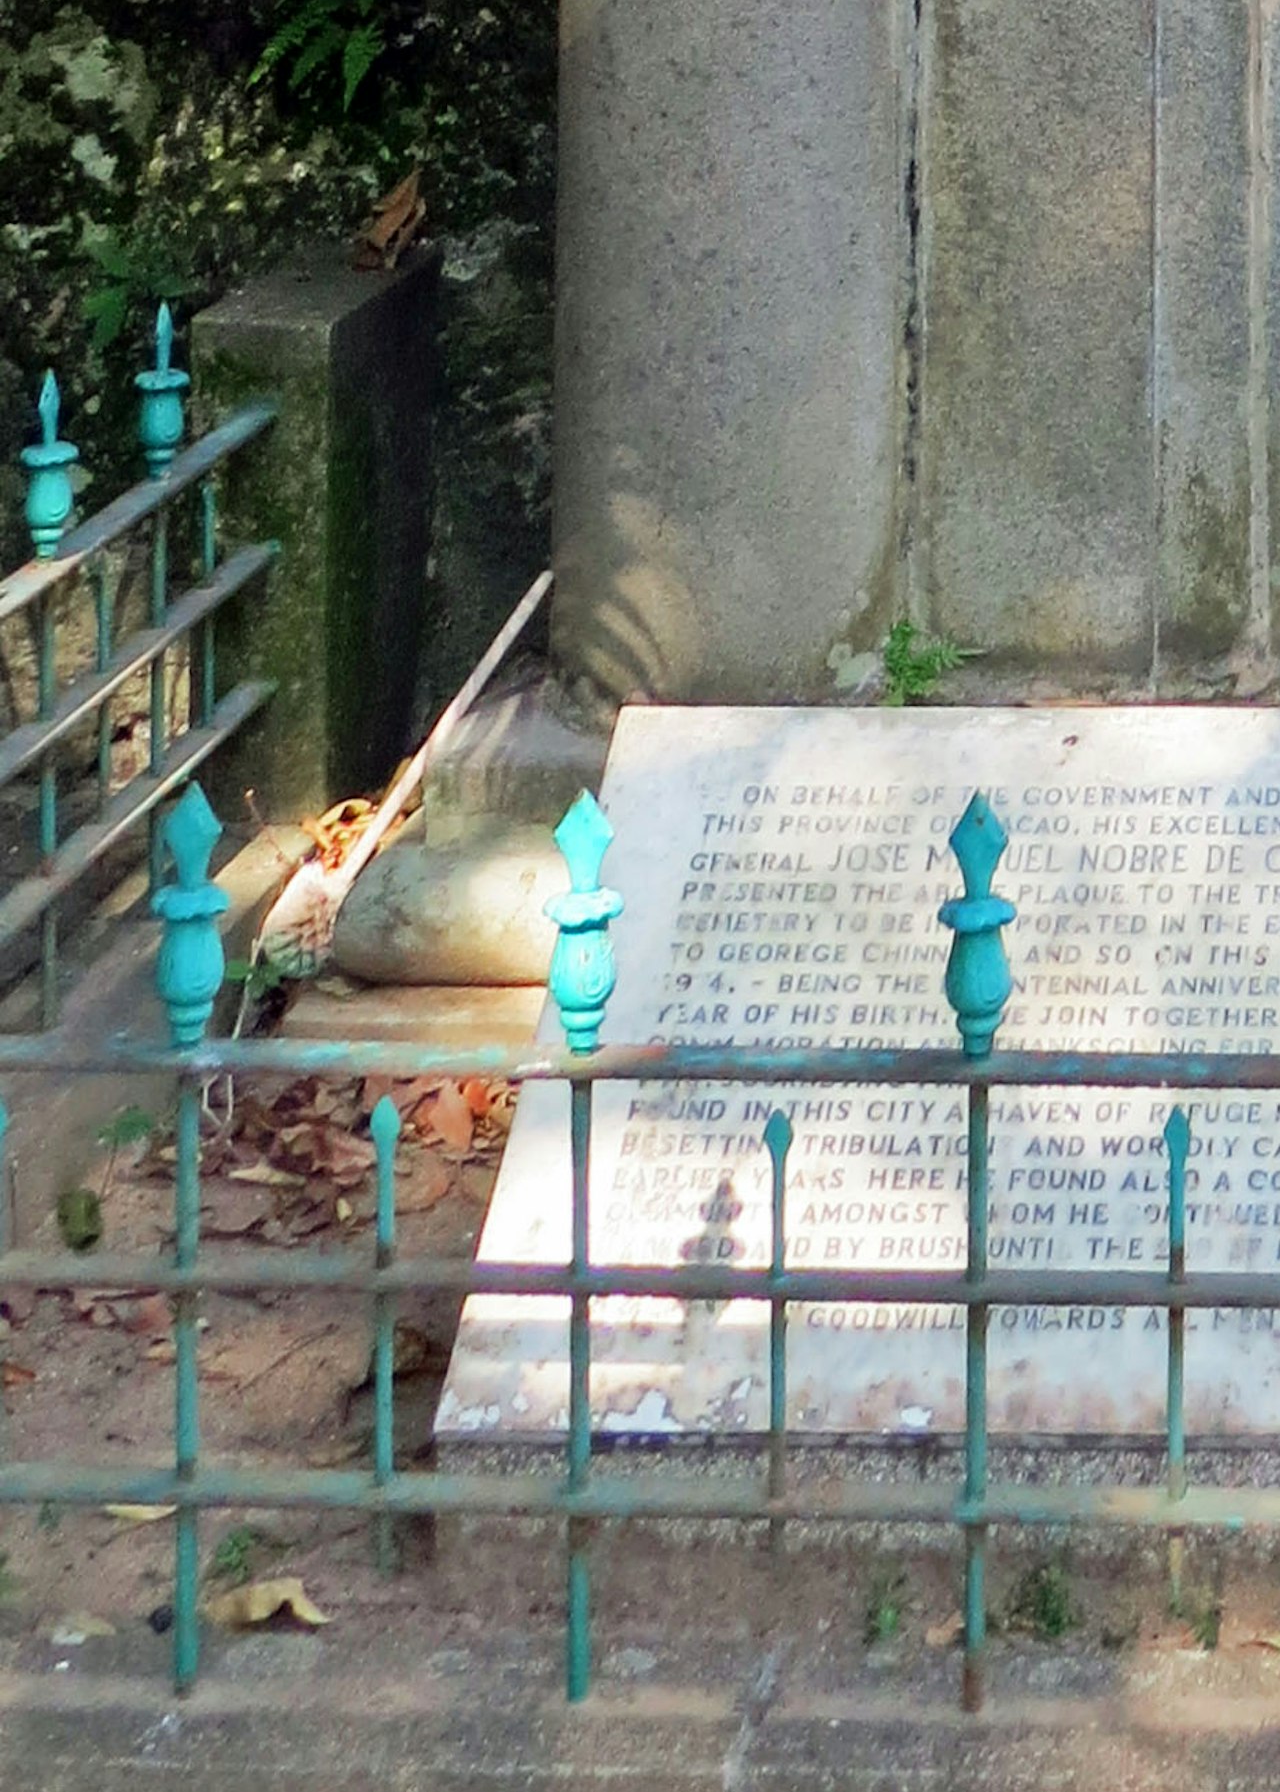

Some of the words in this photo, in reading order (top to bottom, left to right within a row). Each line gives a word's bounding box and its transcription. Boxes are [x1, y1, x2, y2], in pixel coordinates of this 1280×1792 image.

[743, 785, 779, 807] ON
[789, 784, 898, 807] BEHALF
[911, 784, 945, 807] OF
[1021, 785, 1214, 807] GOVERNMENT
[702, 814, 763, 836] THIS
[777, 814, 913, 835] PROVINCE
[1091, 815, 1138, 836] HIS
[689, 852, 813, 874] GENERAL
[827, 844, 909, 873] JOSE
[1077, 845, 1189, 874] NOBRE
[1205, 845, 1246, 874] DE
[680, 882, 838, 904] PRESENTED
[850, 883, 901, 904] THE
[1017, 884, 1128, 906] PLAQUE
[1139, 884, 1174, 905] TO
[1188, 884, 1242, 905] THE
[674, 912, 826, 934] CEMETERY
[833, 913, 869, 934] TO
[880, 913, 916, 934] BE
[1159, 914, 1187, 935] IN
[1199, 914, 1250, 935] THE
[669, 942, 704, 964] TO
[1023, 945, 1084, 966] AND
[1094, 945, 1133, 965] SO
[1154, 945, 1194, 966] ON
[1208, 945, 1269, 967] THIS
[776, 972, 862, 994] BEING
[875, 973, 931, 993] THE
[657, 1003, 728, 1025] YEAR
[744, 1003, 780, 1025] OF
[789, 1003, 839, 1025] HIS
[1041, 1006, 1108, 1026] JOIN
[1133, 1007, 1279, 1028] TOGETHER
[743, 1100, 772, 1122] IN
[787, 1099, 852, 1122] THIS
[865, 1100, 937, 1122] CITY
[944, 1101, 966, 1122] A
[986, 1102, 1085, 1124] HAVEN
[1094, 1102, 1134, 1123] OF
[1023, 1136, 1085, 1158] AND
[865, 1168, 946, 1191] HERE
[1006, 1169, 1107, 1192] FOUND
[1212, 1170, 1233, 1192] A
[799, 1203, 950, 1224] AMONGST
[1067, 1203, 1110, 1225] HE
[823, 1236, 865, 1260] BY
[1087, 1238, 1143, 1260] THE
[806, 1307, 966, 1330] GOODWILL
